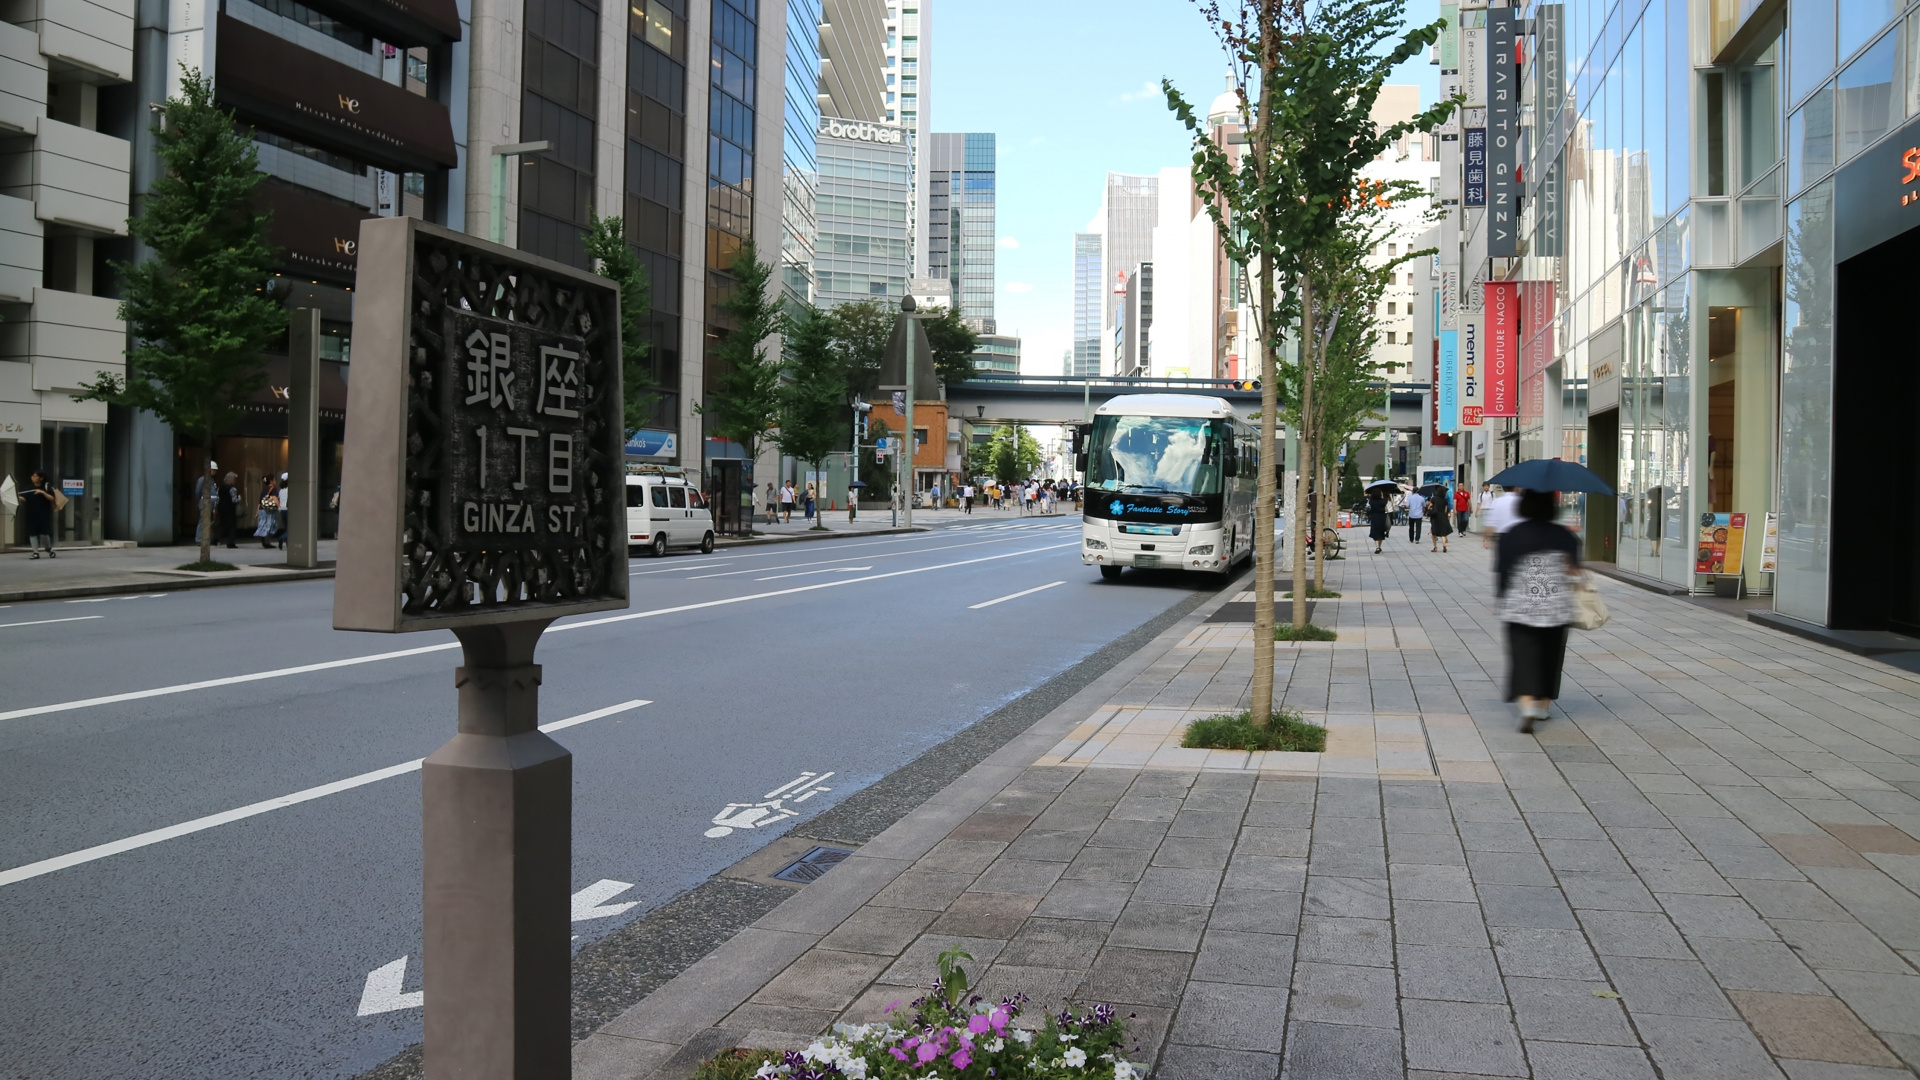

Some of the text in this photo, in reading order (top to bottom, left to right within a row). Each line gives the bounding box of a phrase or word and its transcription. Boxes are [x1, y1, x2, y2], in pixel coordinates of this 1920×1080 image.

[829, 119, 900, 144] brother
[1496, 21, 1507, 241] KIRARITO GINZA
[1467, 132, 1483, 203] 藤見歯科
[465, 328, 580, 419] 銀座
[1466, 323, 1477, 397] memoria
[1495, 286, 1505, 412] GINZA COUTURE NAOCO
[475, 424, 573, 493] 1丁目
[463, 501, 536, 534] GINZA
[1126, 503, 1163, 513] Fantastic
[1166, 505, 1191, 516] Story
